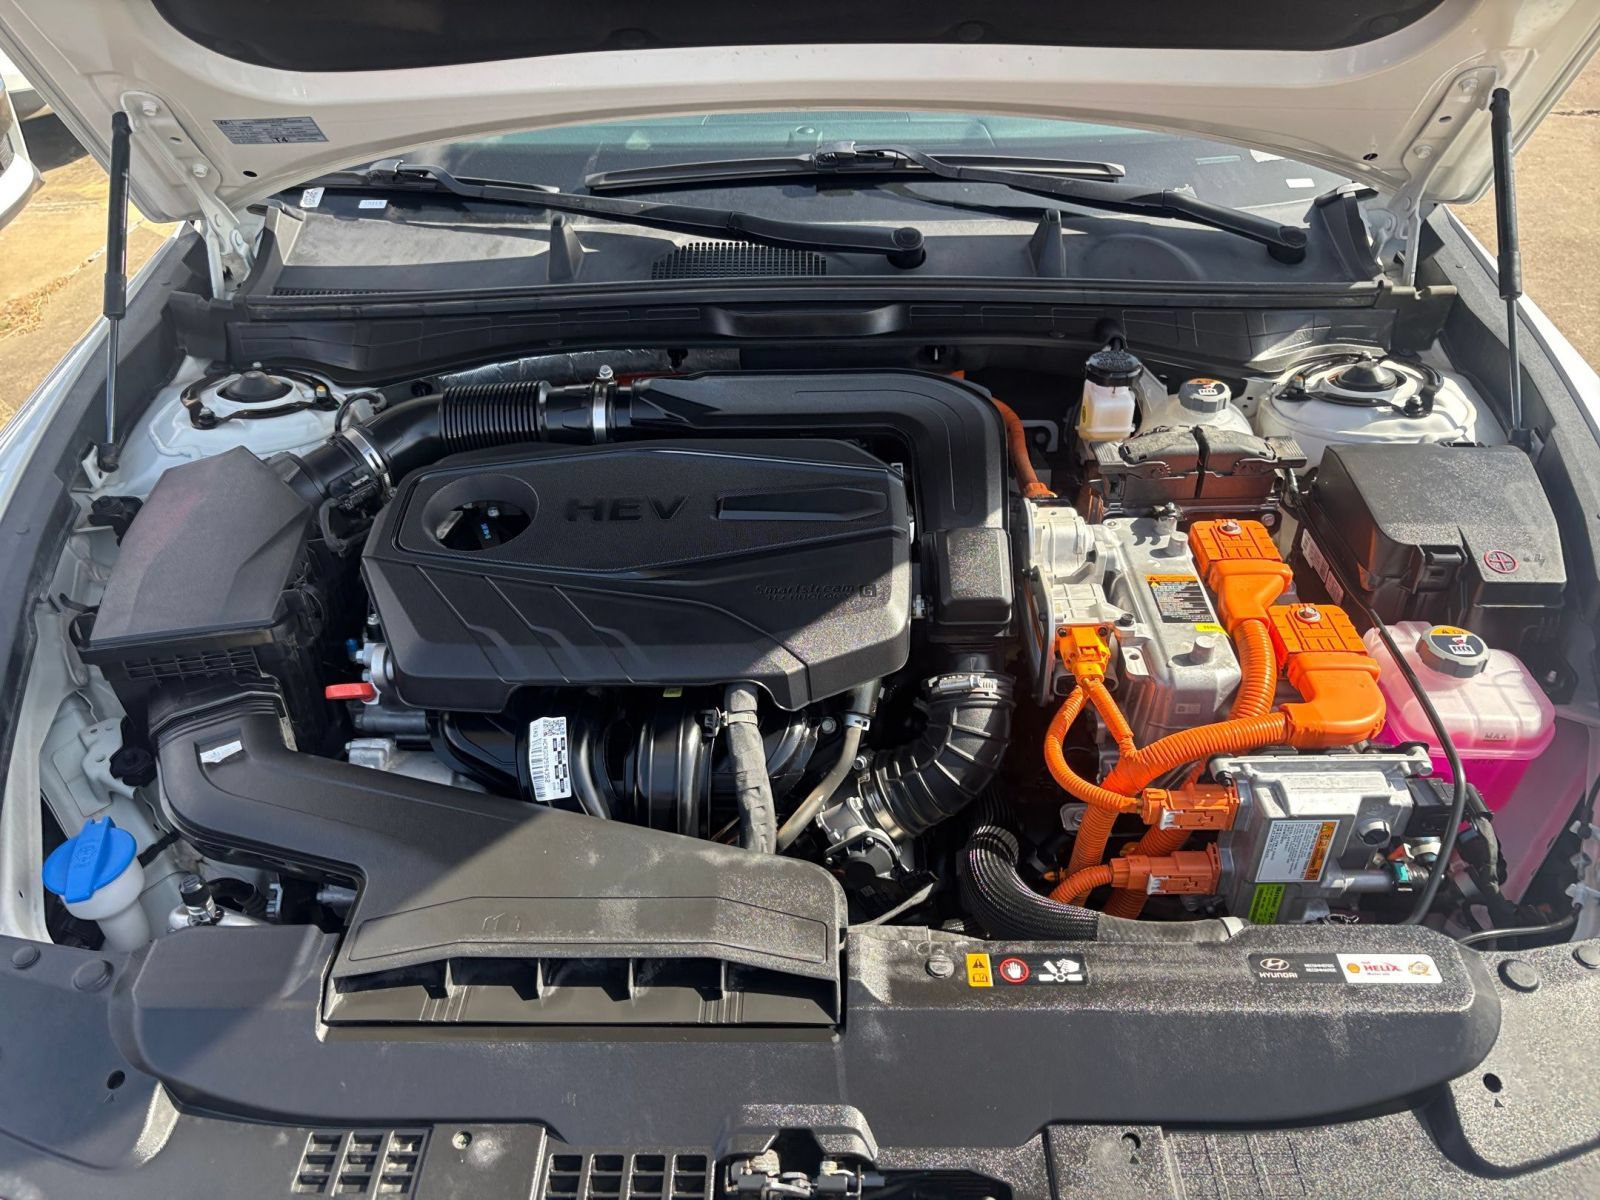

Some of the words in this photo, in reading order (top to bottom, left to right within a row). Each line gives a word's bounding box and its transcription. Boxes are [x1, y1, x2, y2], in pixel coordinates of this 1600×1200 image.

[564, 495, 689, 521] HEV
[754, 584, 855, 595] Smartstream
[861, 585, 875, 597] G
[1363, 963, 1401, 972] HELIX
[1258, 971, 1298, 979] HYUNDAI
